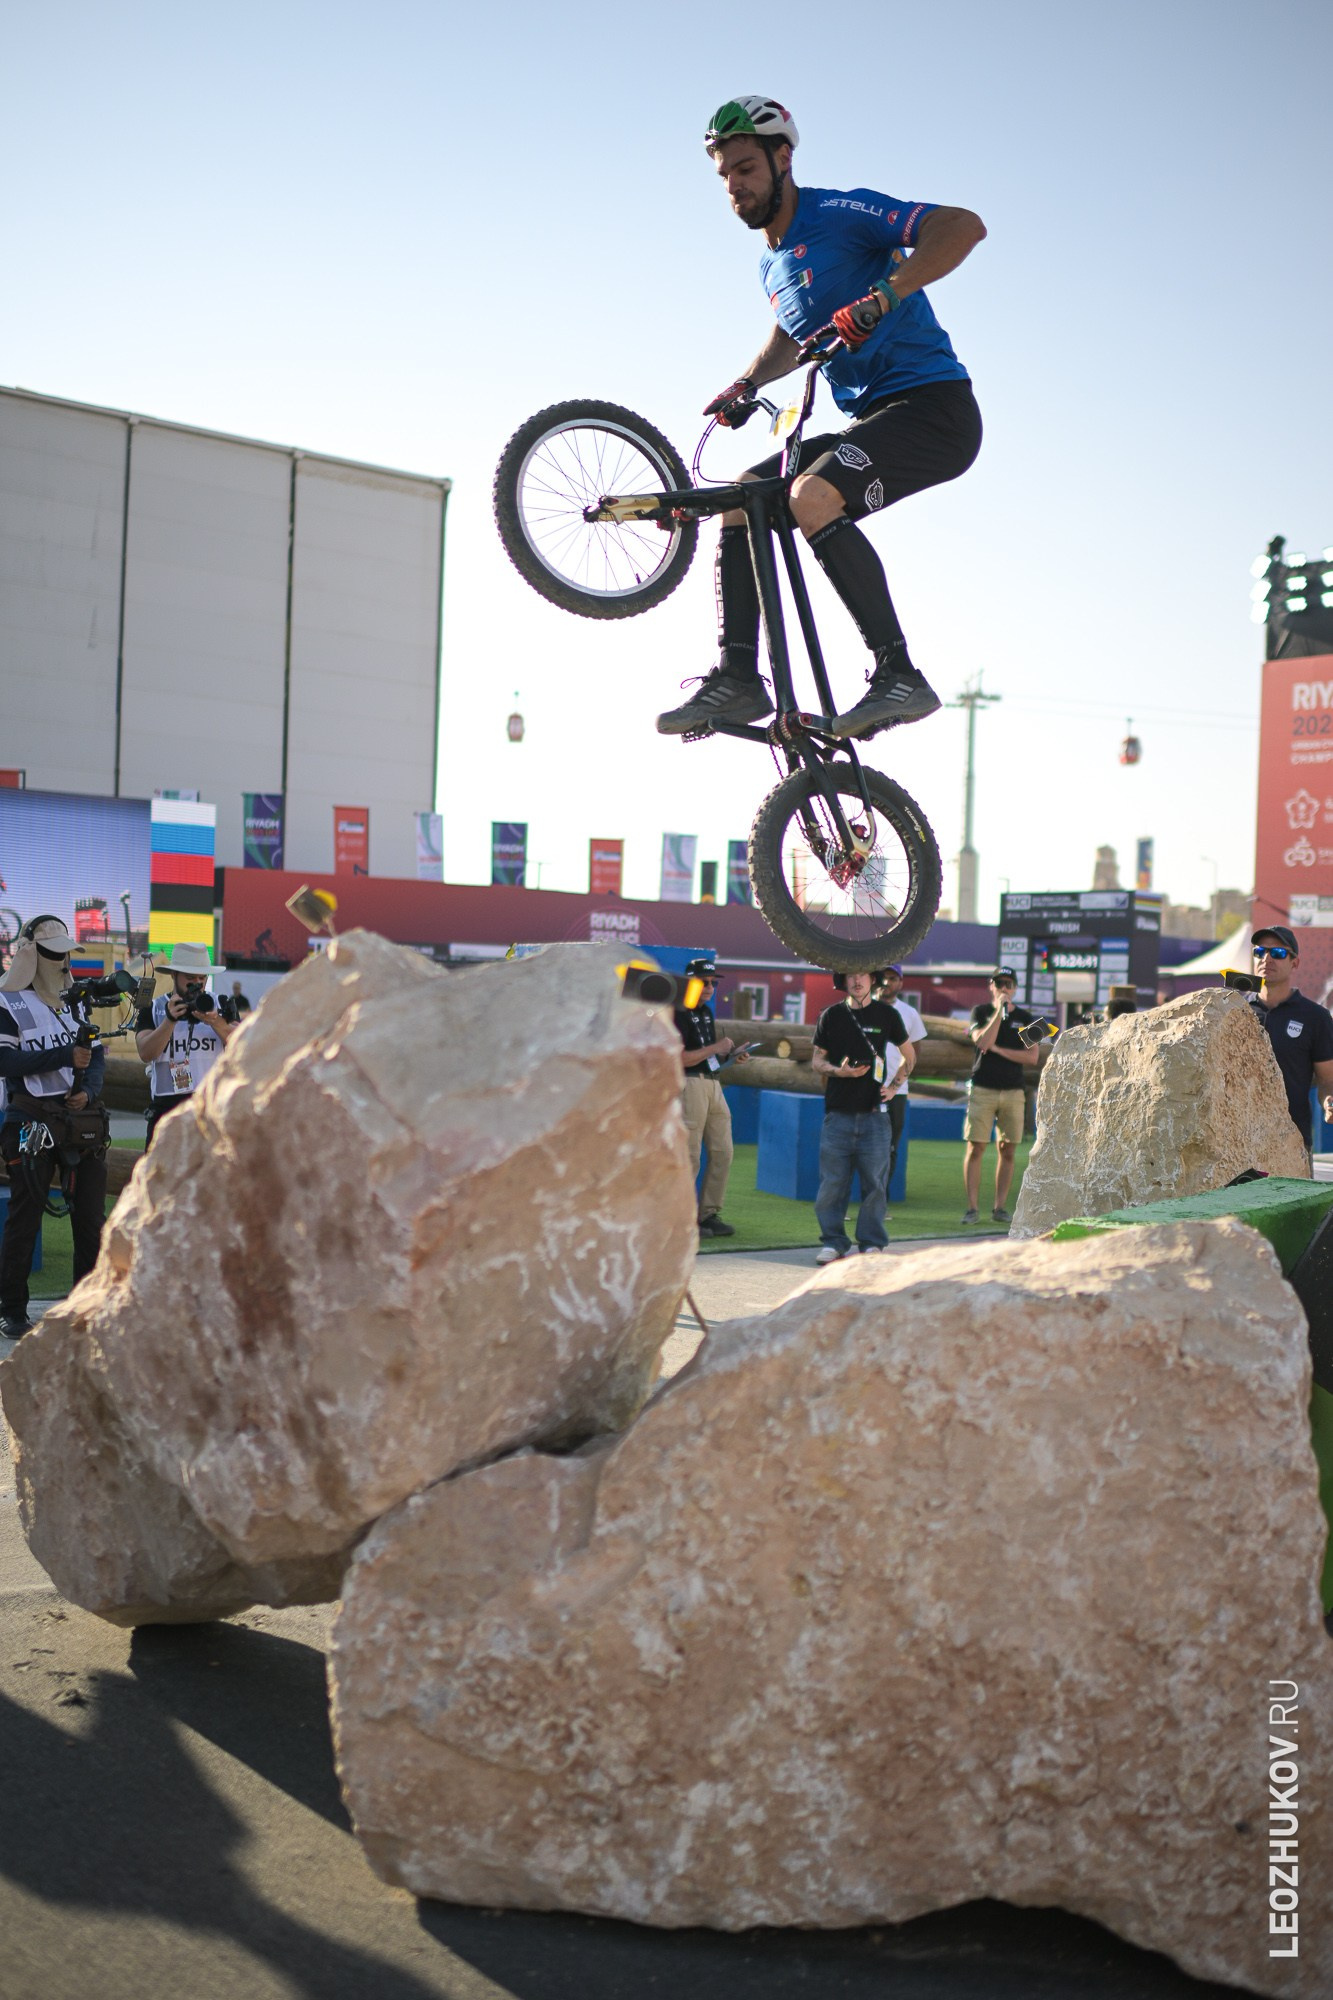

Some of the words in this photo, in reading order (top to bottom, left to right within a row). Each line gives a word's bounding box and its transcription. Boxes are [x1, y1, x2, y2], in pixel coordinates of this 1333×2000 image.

[1293, 681, 1333, 711] RIY
[1291, 753, 1333, 765] CHAMP
[591, 912, 639, 930] RIYADH
[1049, 922, 1080, 932] FINISH
[11, 1001, 27, 1010] 356
[26, 1036, 46, 1051] TV
[175, 1038, 217, 1052] HOST
